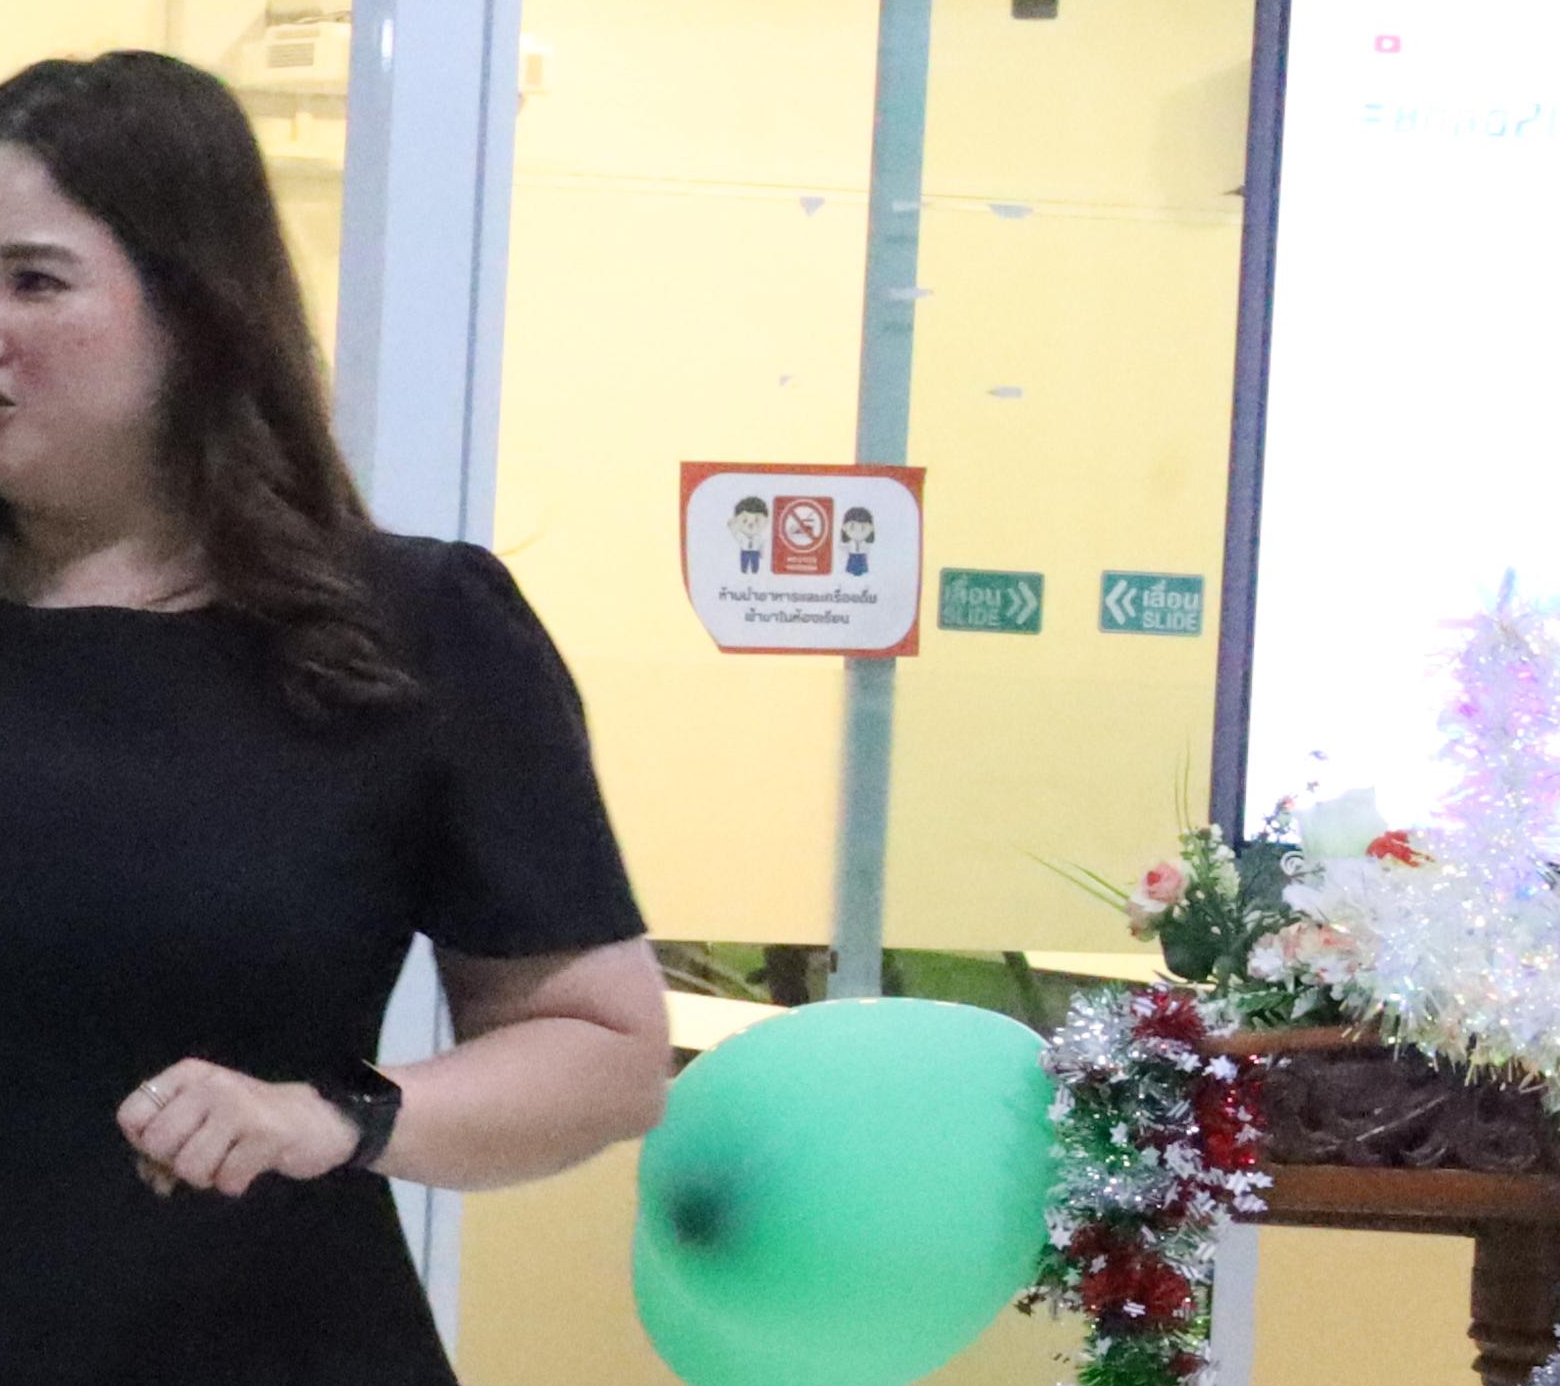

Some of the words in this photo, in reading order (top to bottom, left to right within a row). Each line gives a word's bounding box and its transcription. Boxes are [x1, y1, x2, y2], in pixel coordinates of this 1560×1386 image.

[1142, 579, 1200, 610] เลื่อน
[942, 607, 1001, 627] SLIDE
[1142, 611, 1199, 632] SLIDE
